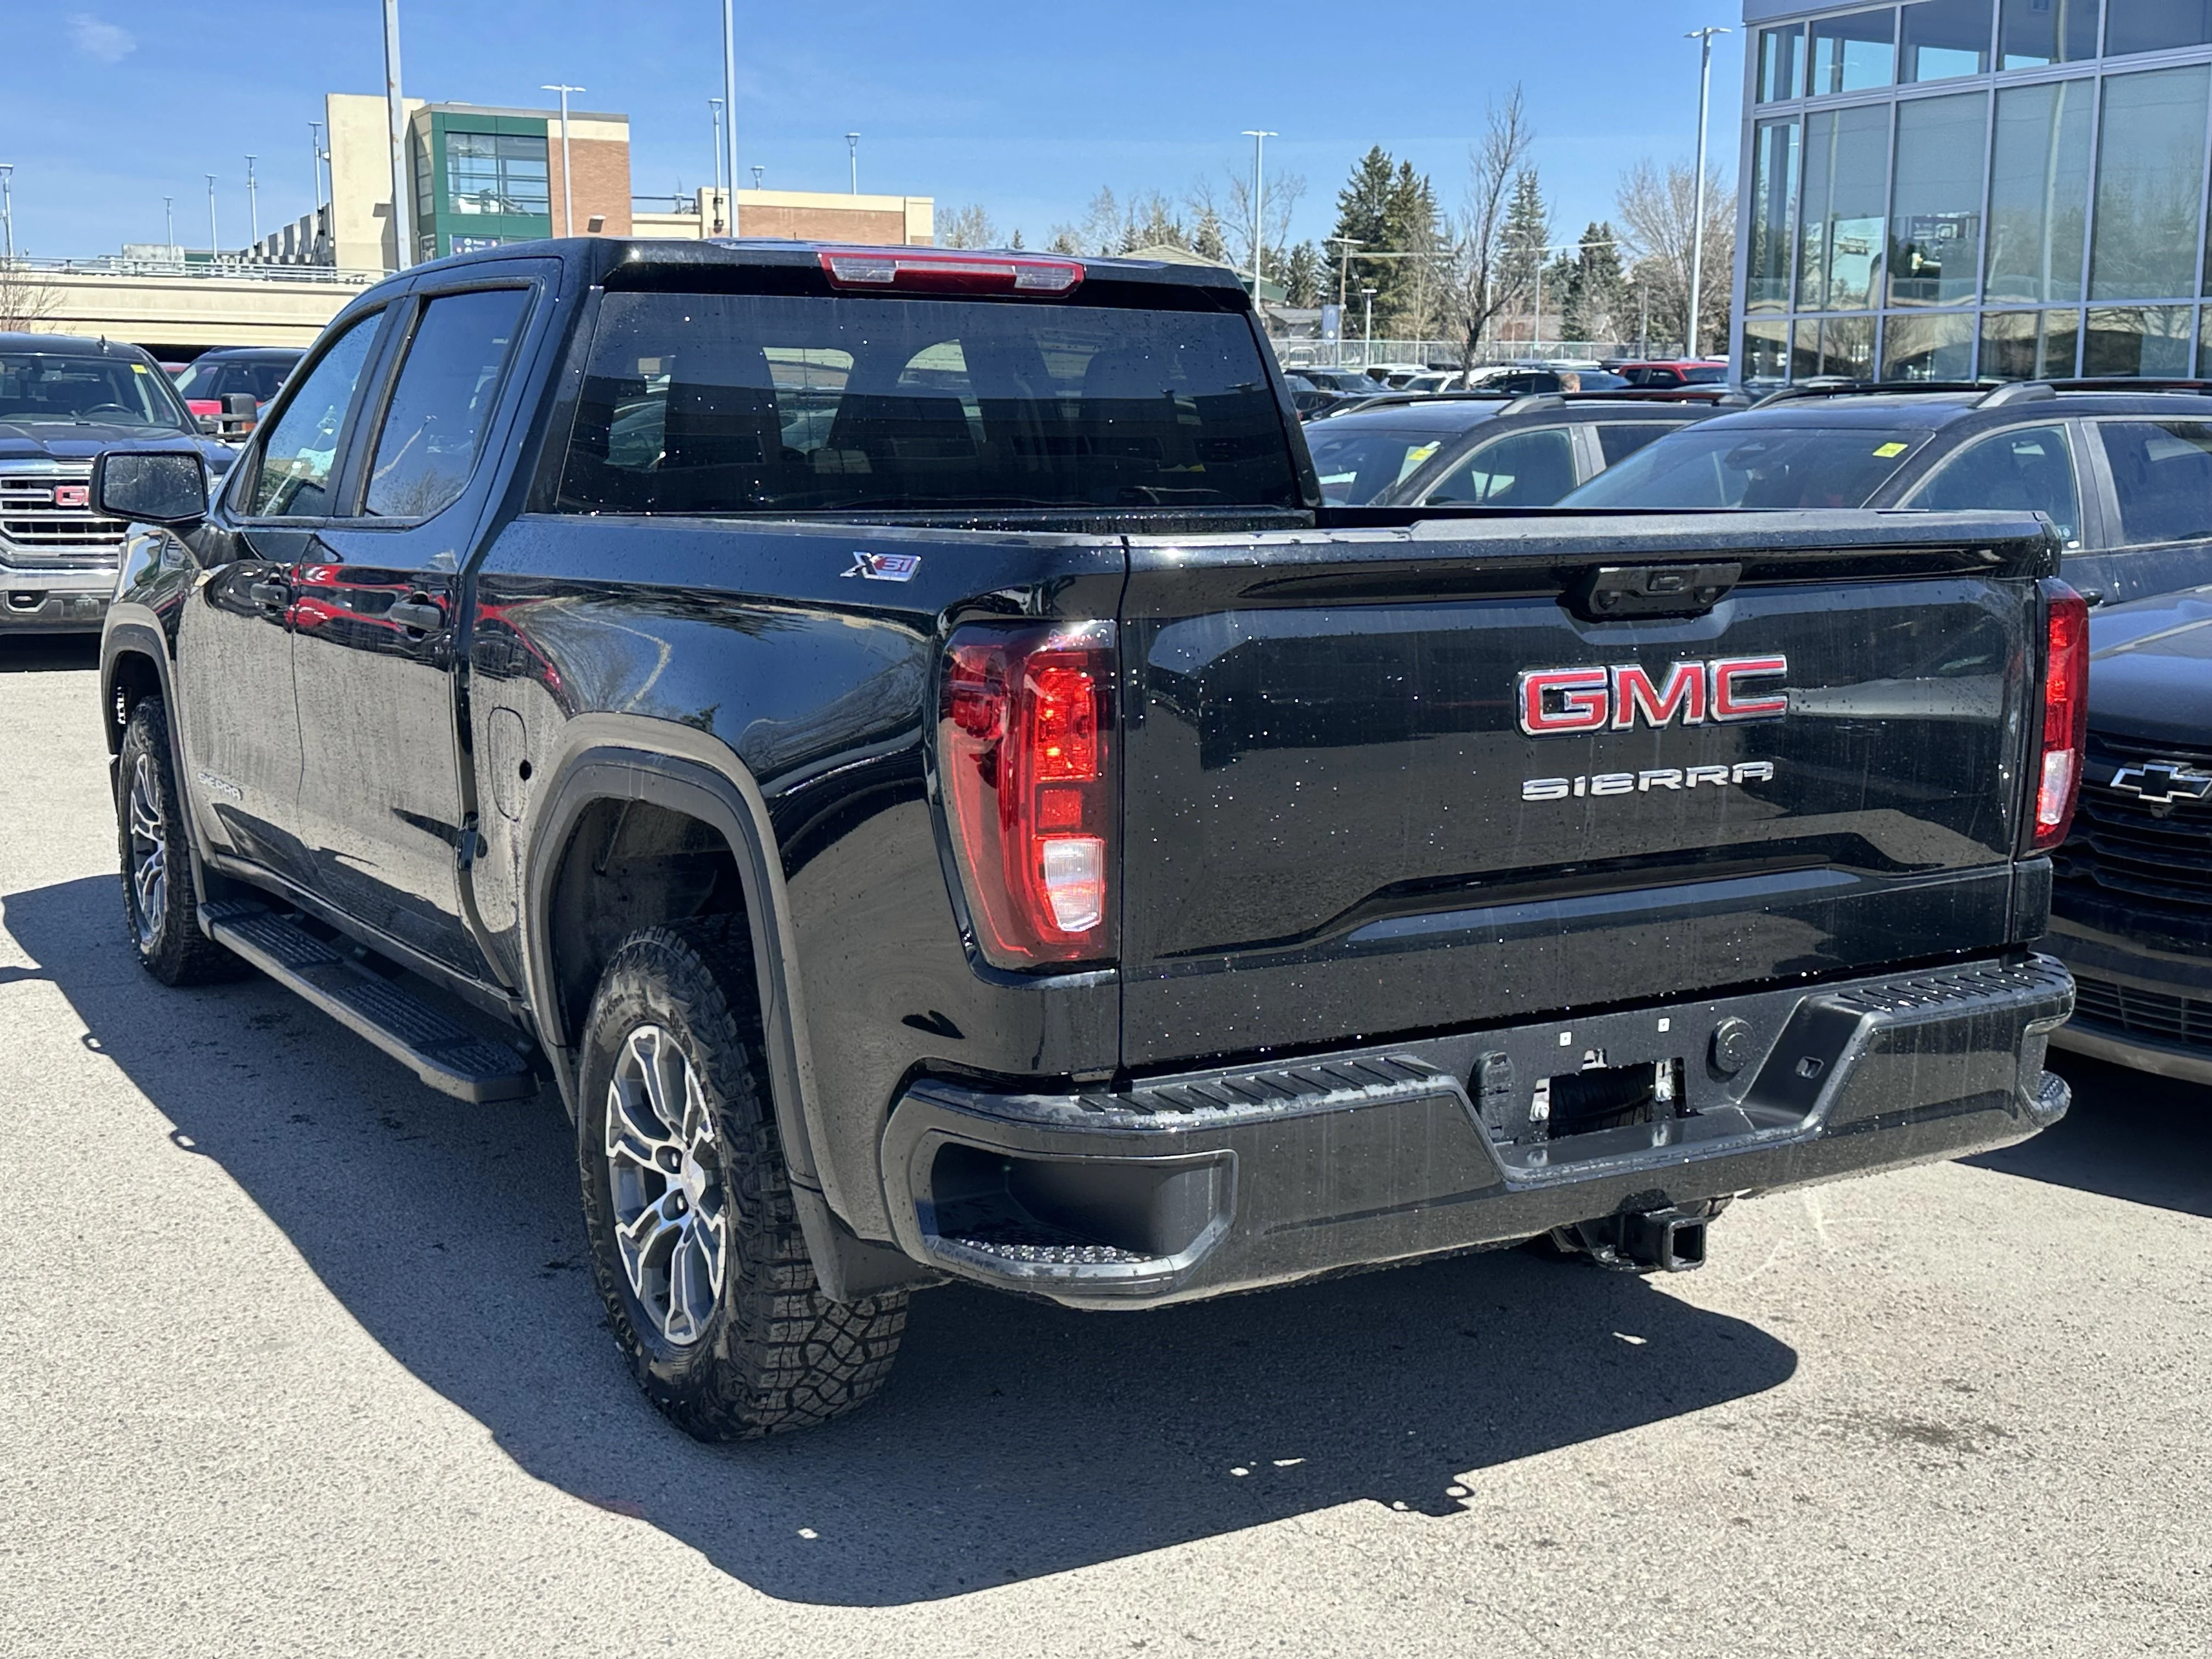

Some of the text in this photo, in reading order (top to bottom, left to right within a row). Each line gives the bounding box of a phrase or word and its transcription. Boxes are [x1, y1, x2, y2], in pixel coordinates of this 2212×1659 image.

[840, 551, 922, 582] X31
[1519, 654, 1787, 736] GMC
[198, 772, 242, 800] SIERRA
[1521, 761, 1774, 801] SIERRA
